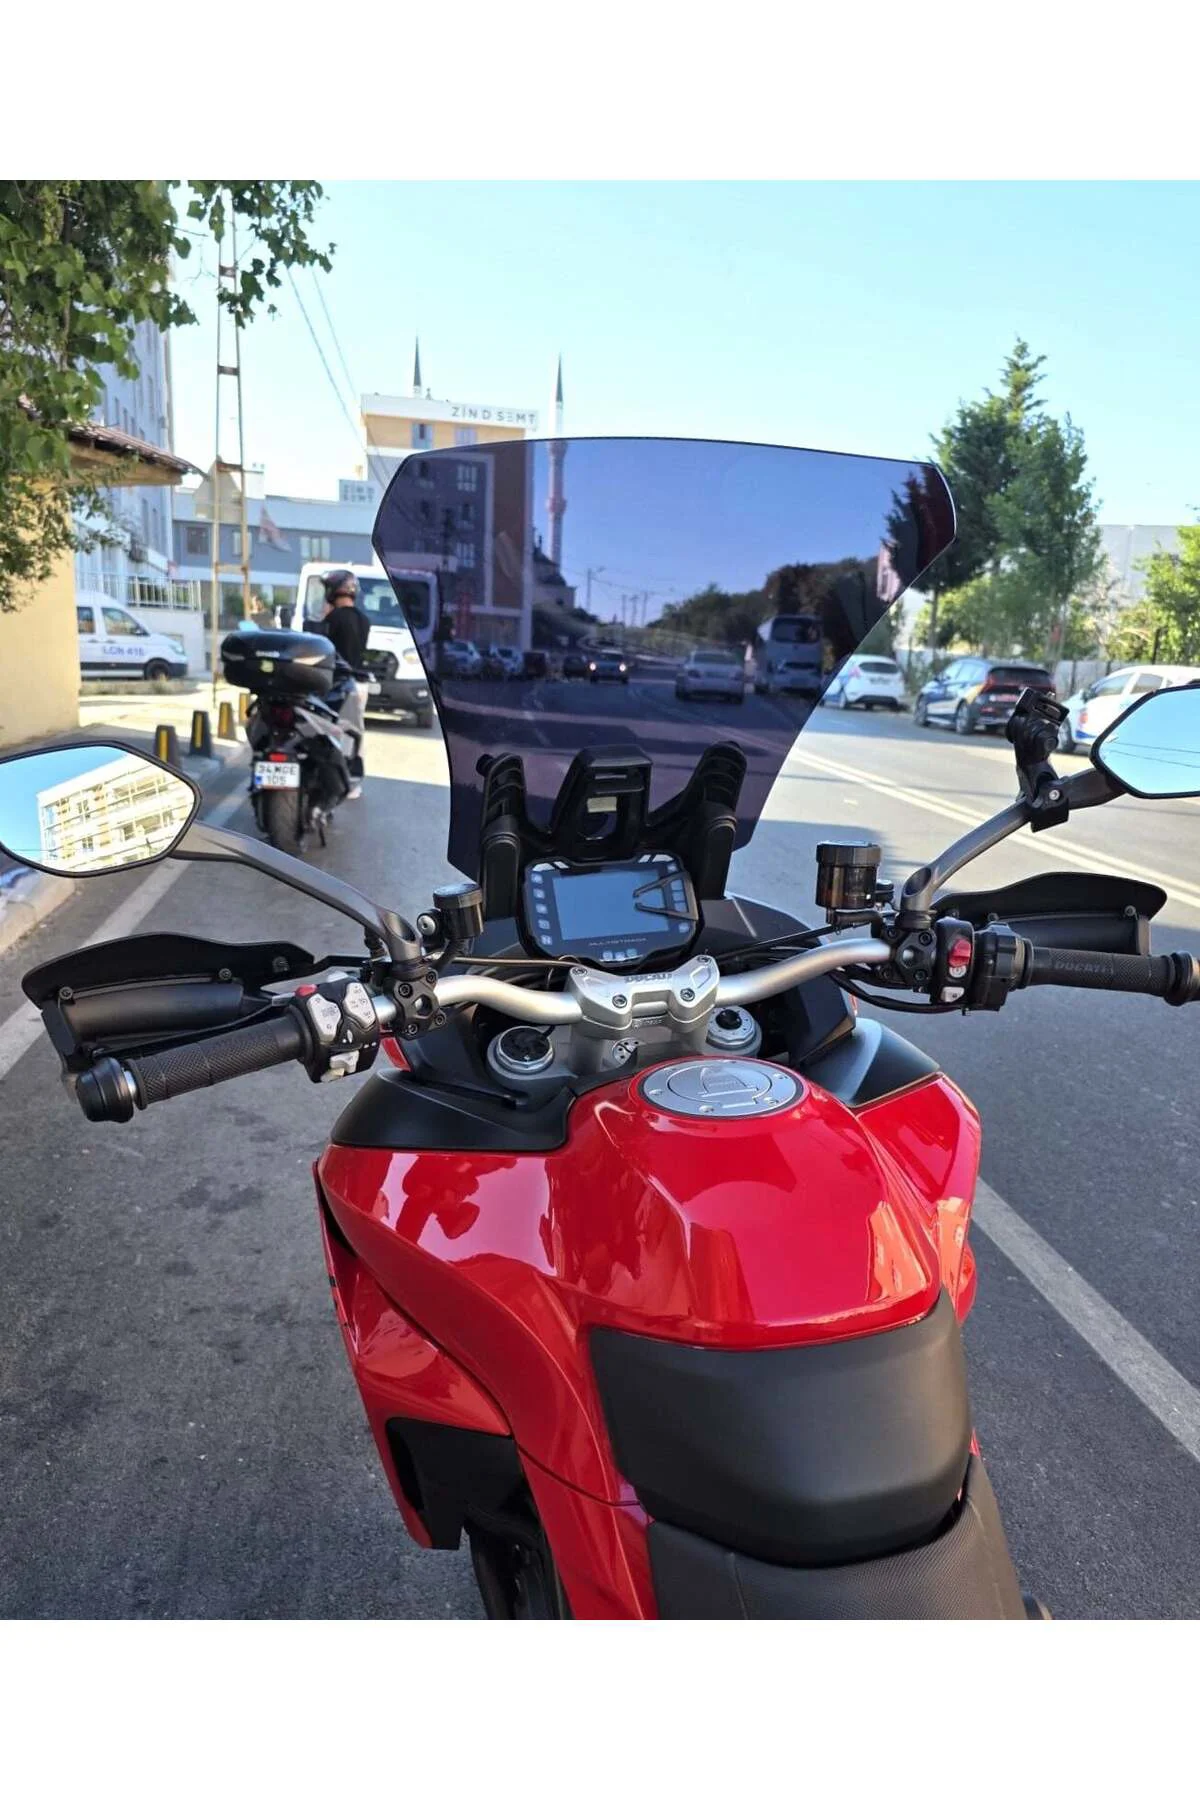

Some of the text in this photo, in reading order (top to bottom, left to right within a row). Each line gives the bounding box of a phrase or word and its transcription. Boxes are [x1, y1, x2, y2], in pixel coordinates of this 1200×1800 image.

[496, 410, 536, 425] SEMT
[1053, 960, 1108, 975] DUCATI
[623, 972, 673, 984] DUCATI
